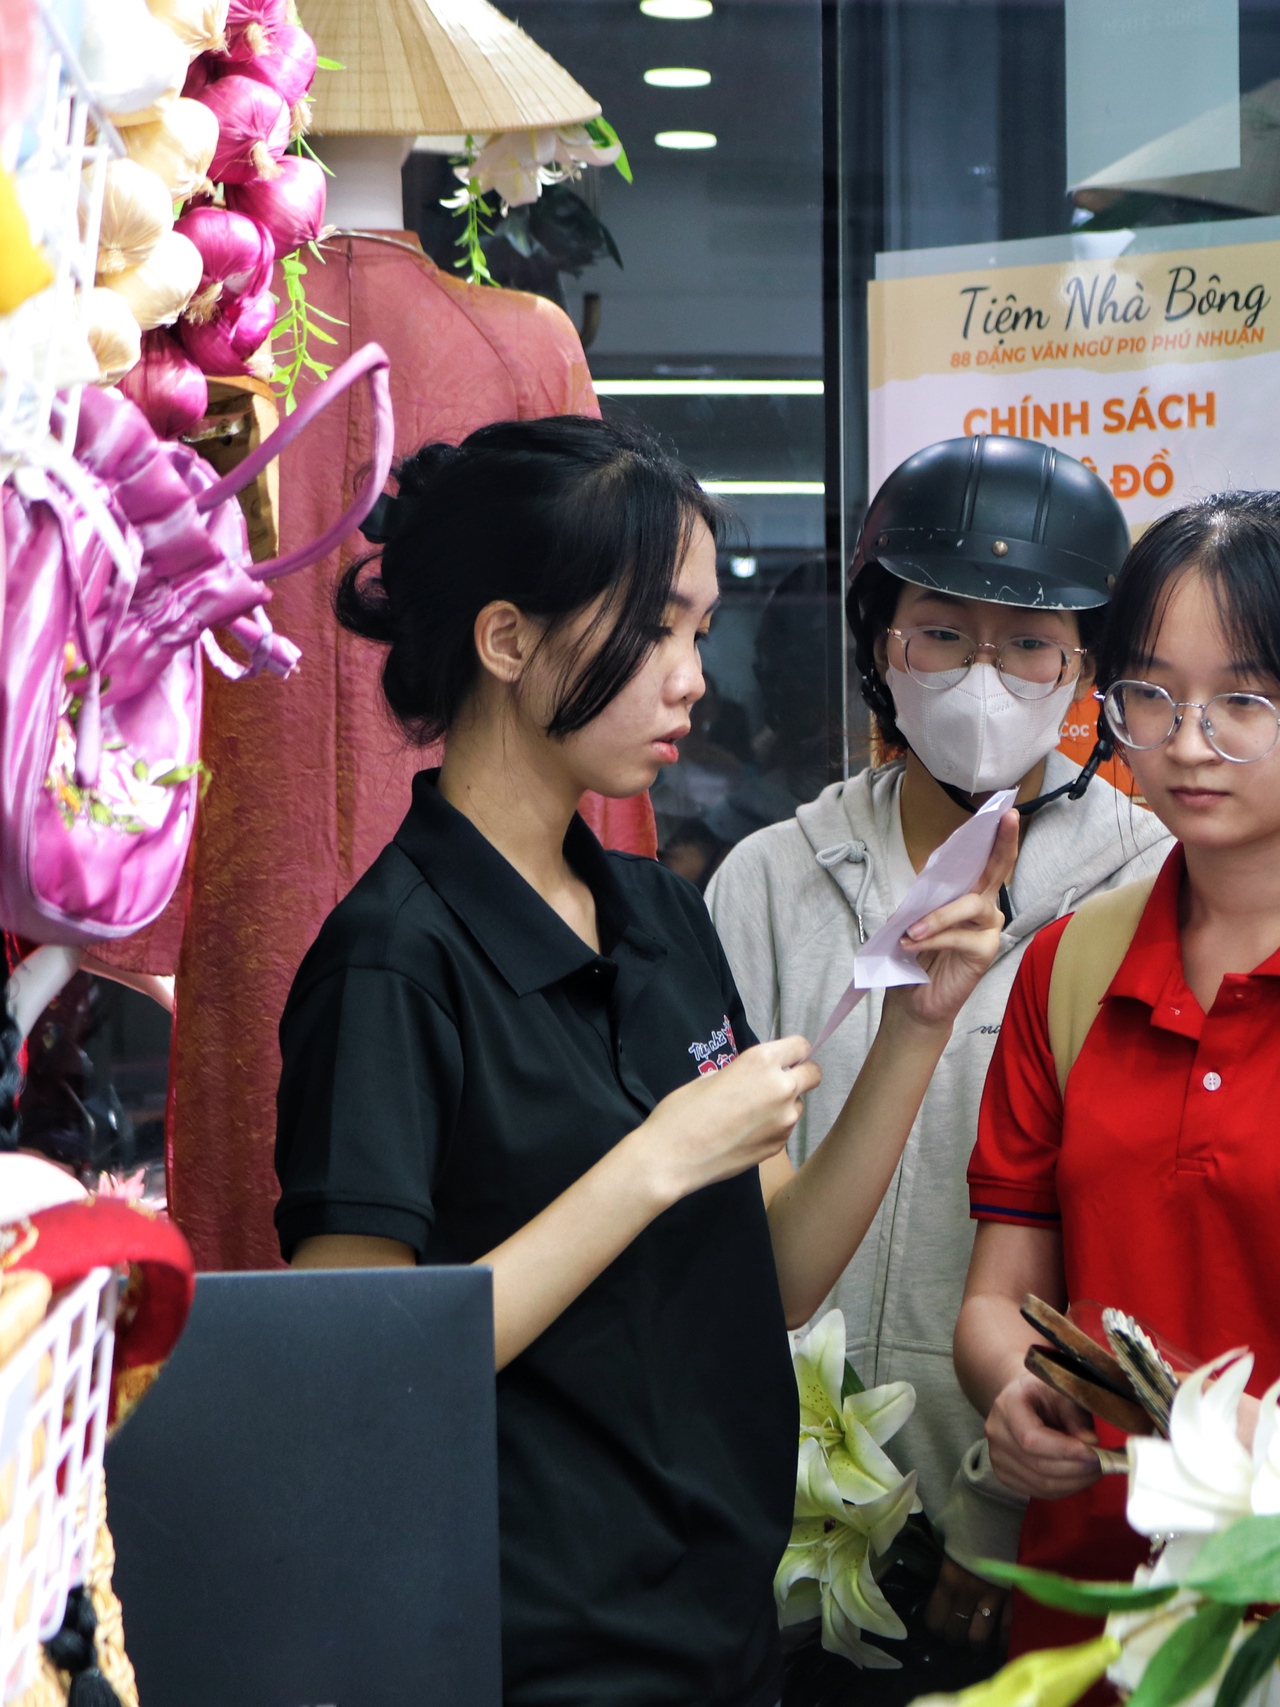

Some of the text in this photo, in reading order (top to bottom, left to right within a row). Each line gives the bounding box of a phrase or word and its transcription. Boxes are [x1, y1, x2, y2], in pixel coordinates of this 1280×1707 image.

[960, 265, 1271, 345] Tiệm Nhà Bông
[950, 324, 1265, 369] 88 ĐẶNG VĂN NGỮ P10 PHÚ NHUẬN
[963, 387, 1215, 438] CHÍNH SÁCH
[1110, 448, 1174, 498] ĐỒ
